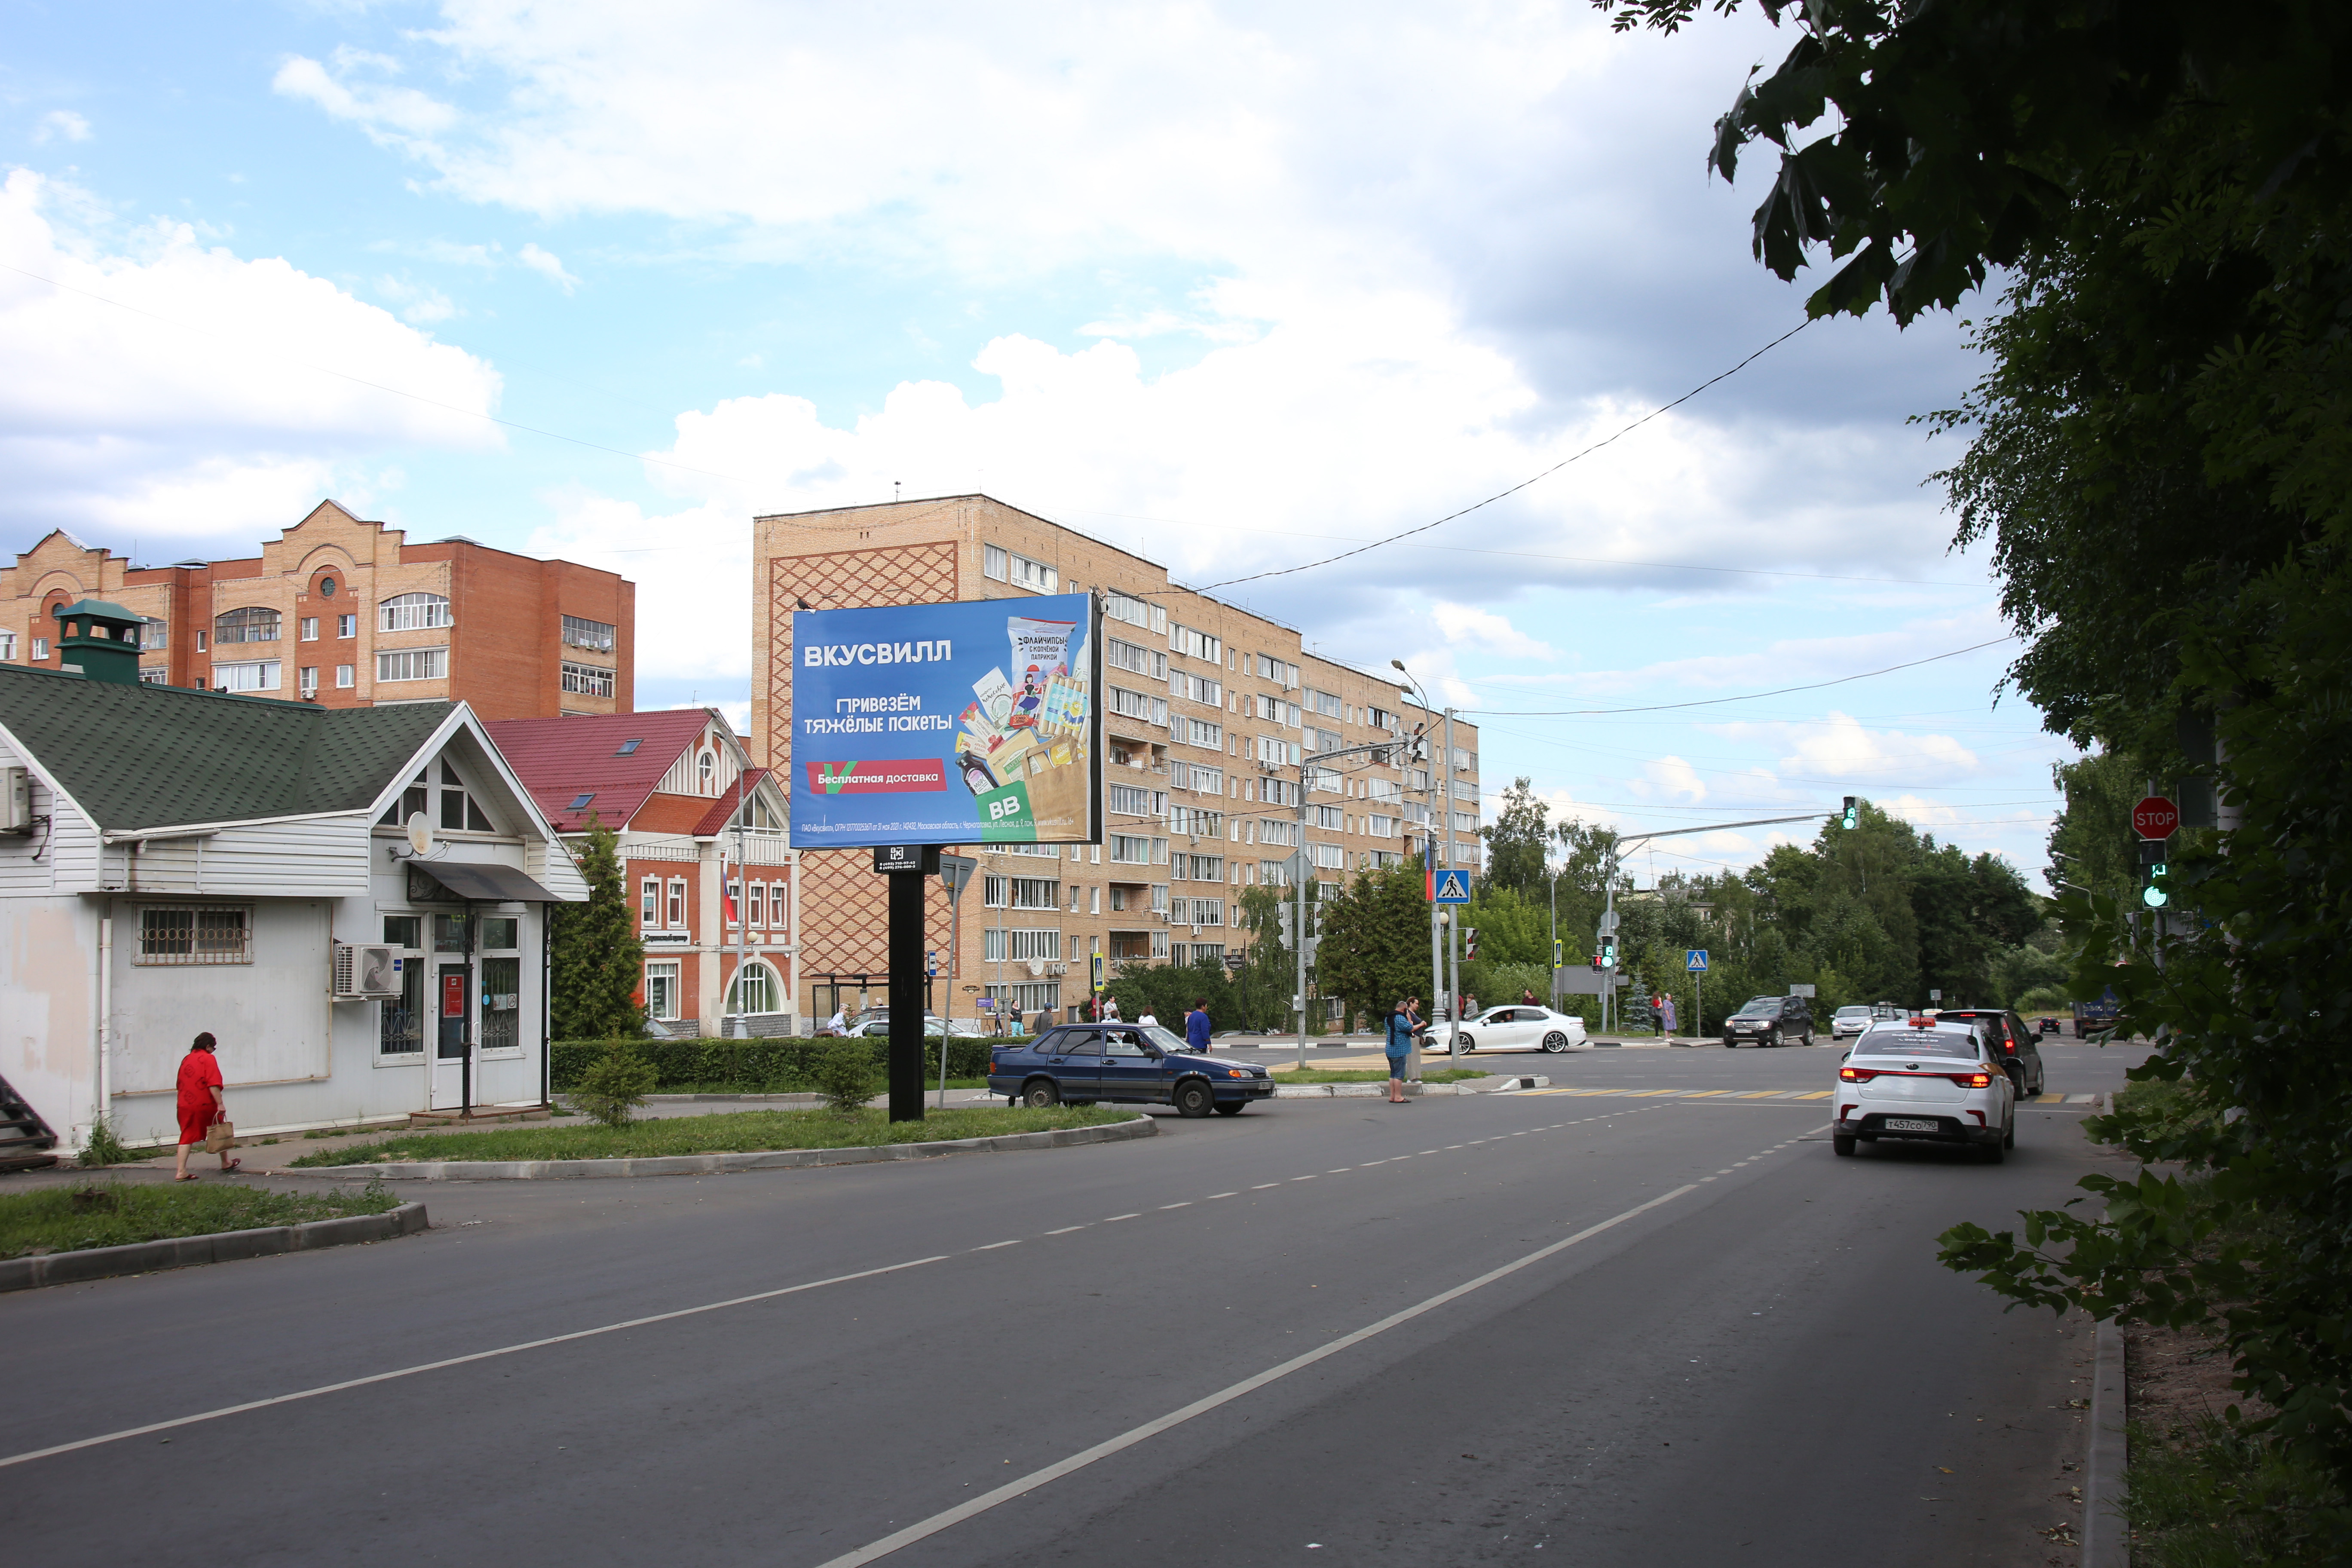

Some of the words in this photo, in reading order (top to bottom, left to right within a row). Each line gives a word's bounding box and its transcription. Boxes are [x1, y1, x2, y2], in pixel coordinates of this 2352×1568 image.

[1023, 636, 1065, 644] ФЛАЙЧИПСЫ
[805, 640, 951, 667] ВКУСВИЛЛ
[818, 774, 883, 784] Бесплатная
[886, 773, 938, 784] доставка
[974, 776, 986, 790] МОРС
[2137, 812, 2175, 825] STOP
[802, 824, 811, 832] ПАО
[890, 822, 899, 830] 2021
[903, 822, 916, 830] 142432,
[917, 822, 941, 830] Московская
[942, 821, 959, 830] область,
[963, 821, 992, 830] Черноголовка,
[999, 819, 1015, 828] Лесная,
[1889, 1120, 1922, 1130] Т457СО
